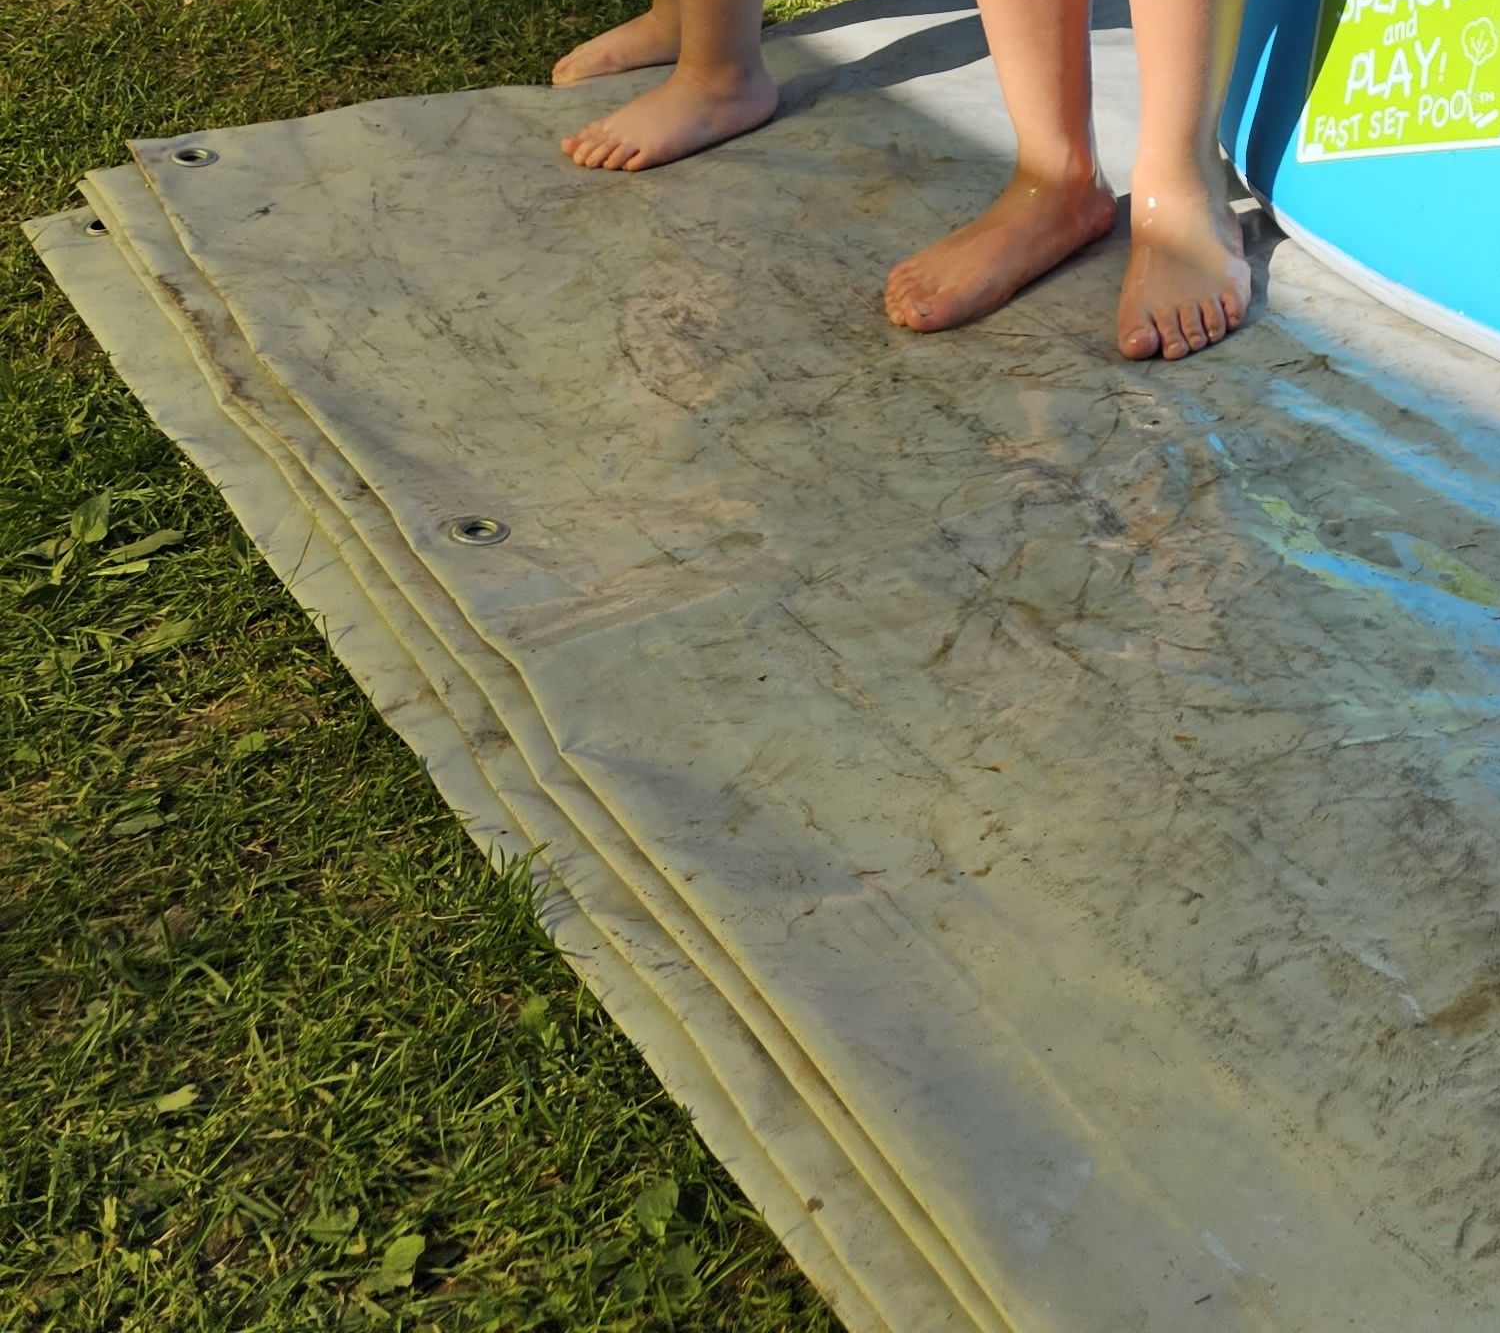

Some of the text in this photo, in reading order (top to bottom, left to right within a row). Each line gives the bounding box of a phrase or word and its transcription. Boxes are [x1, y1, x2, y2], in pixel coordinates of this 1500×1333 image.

[1383, 10, 1418, 46] and
[1344, 36, 1448, 105] PLAY!
[1313, 90, 1499, 148] FAST SET POOL
